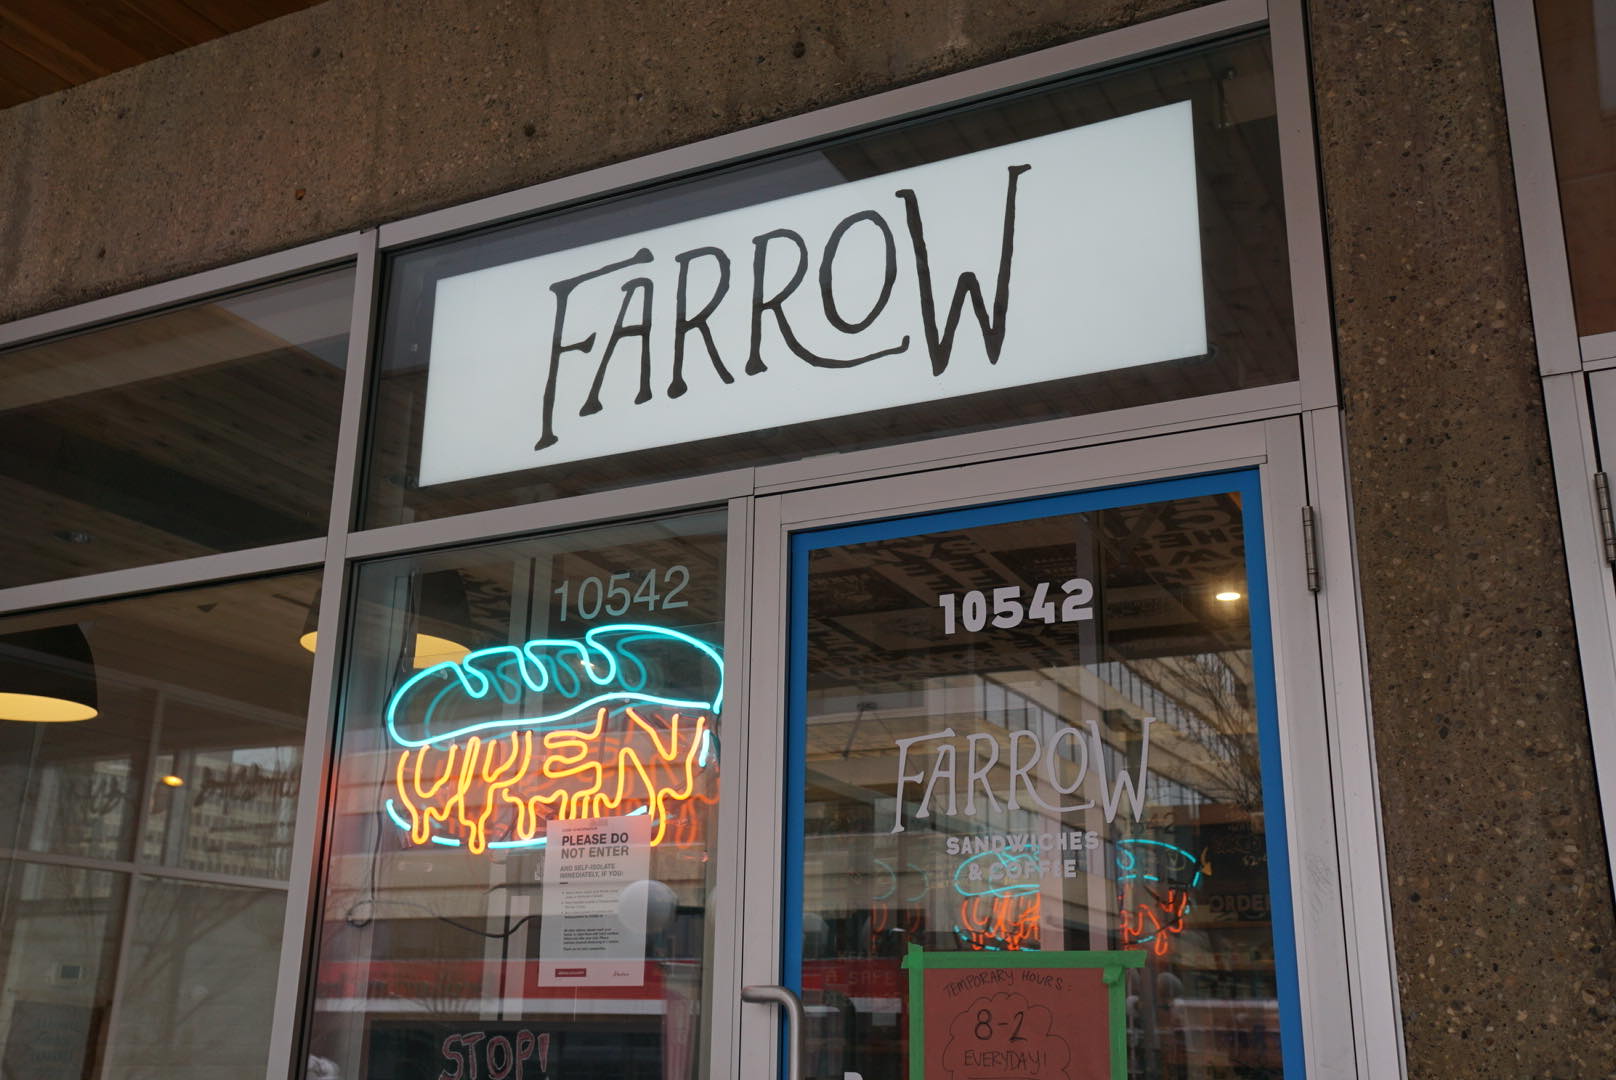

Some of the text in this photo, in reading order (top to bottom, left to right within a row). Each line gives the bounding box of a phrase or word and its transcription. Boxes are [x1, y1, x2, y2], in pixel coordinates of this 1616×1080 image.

[534, 163, 1031, 451] FARROW
[554, 565, 690, 622] 10542
[939, 578, 1094, 635] 10542
[890, 717, 1156, 834] FARROW
[561, 832, 629, 846] PLEASE DO
[561, 845, 629, 859] NOT ENTER
[946, 830, 1099, 855] SANDWICHES
[968, 859, 1077, 881] & COFFEE
[943, 969, 1014, 998] TEMPORARY
[964, 1049, 1047, 1075] EVERYDAY!
